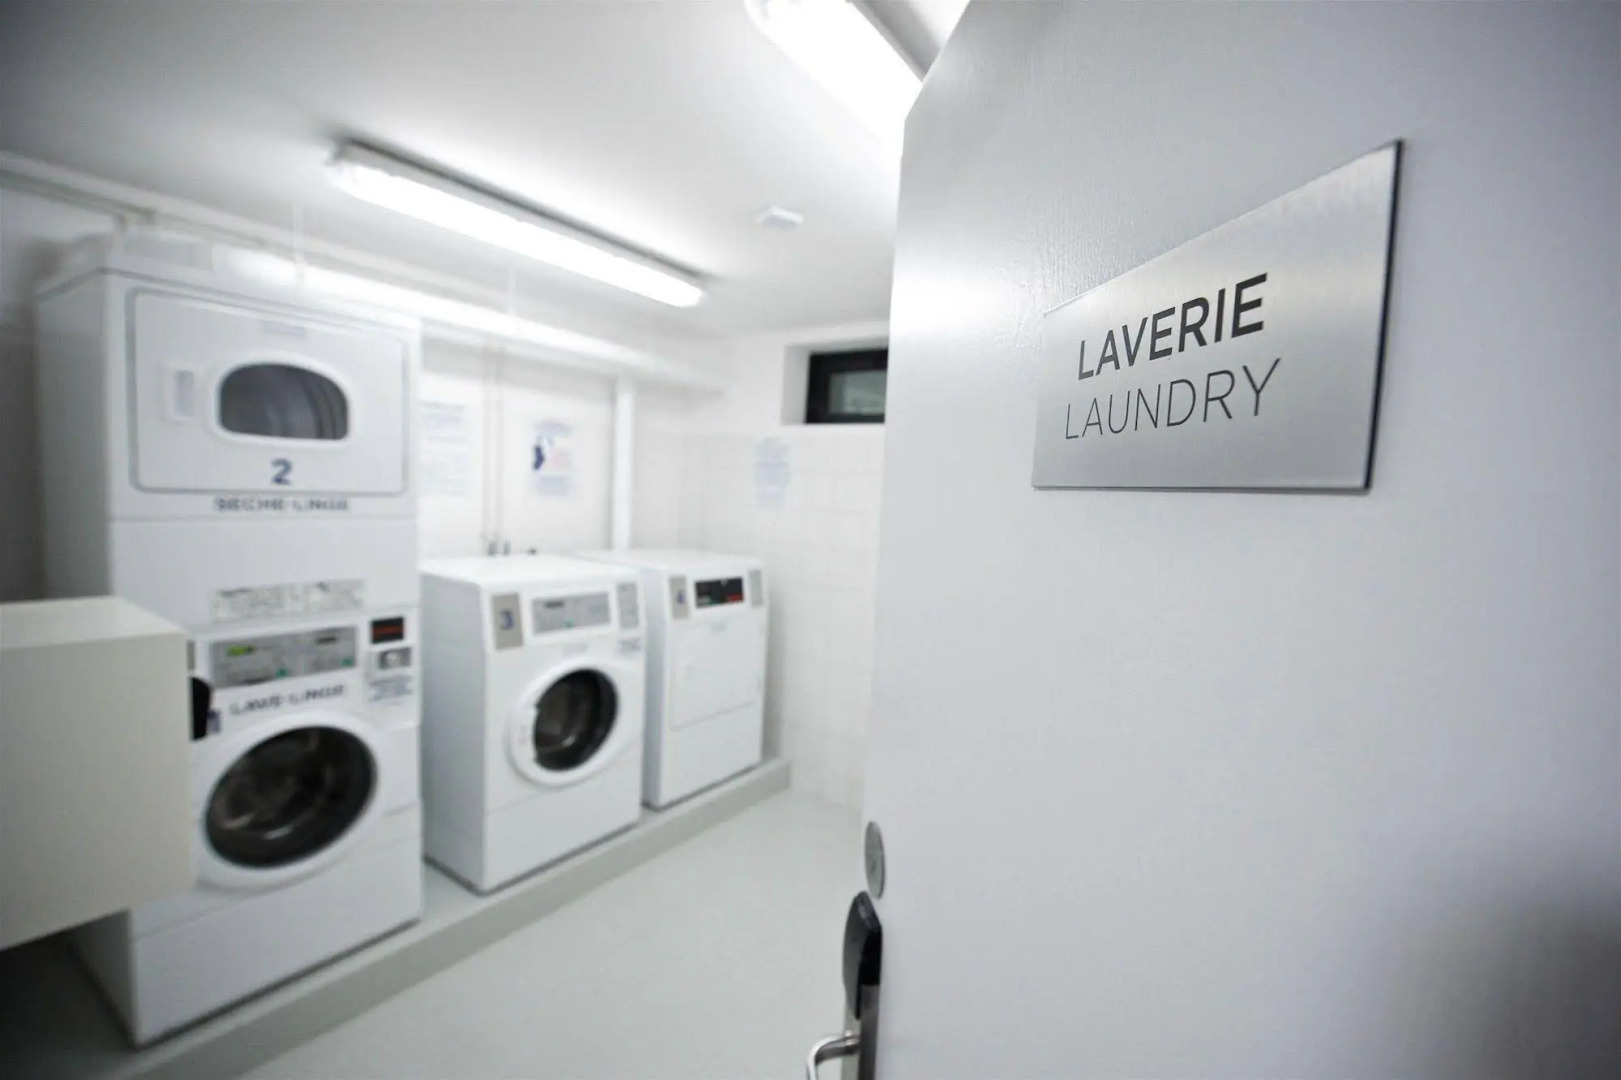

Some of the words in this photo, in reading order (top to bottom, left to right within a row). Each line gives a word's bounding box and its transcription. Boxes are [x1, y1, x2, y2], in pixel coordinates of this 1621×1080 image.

[1078, 272, 1268, 380] LAVERIE
[1065, 357, 1281, 439] LAUNDRY
[270, 457, 293, 485] 2
